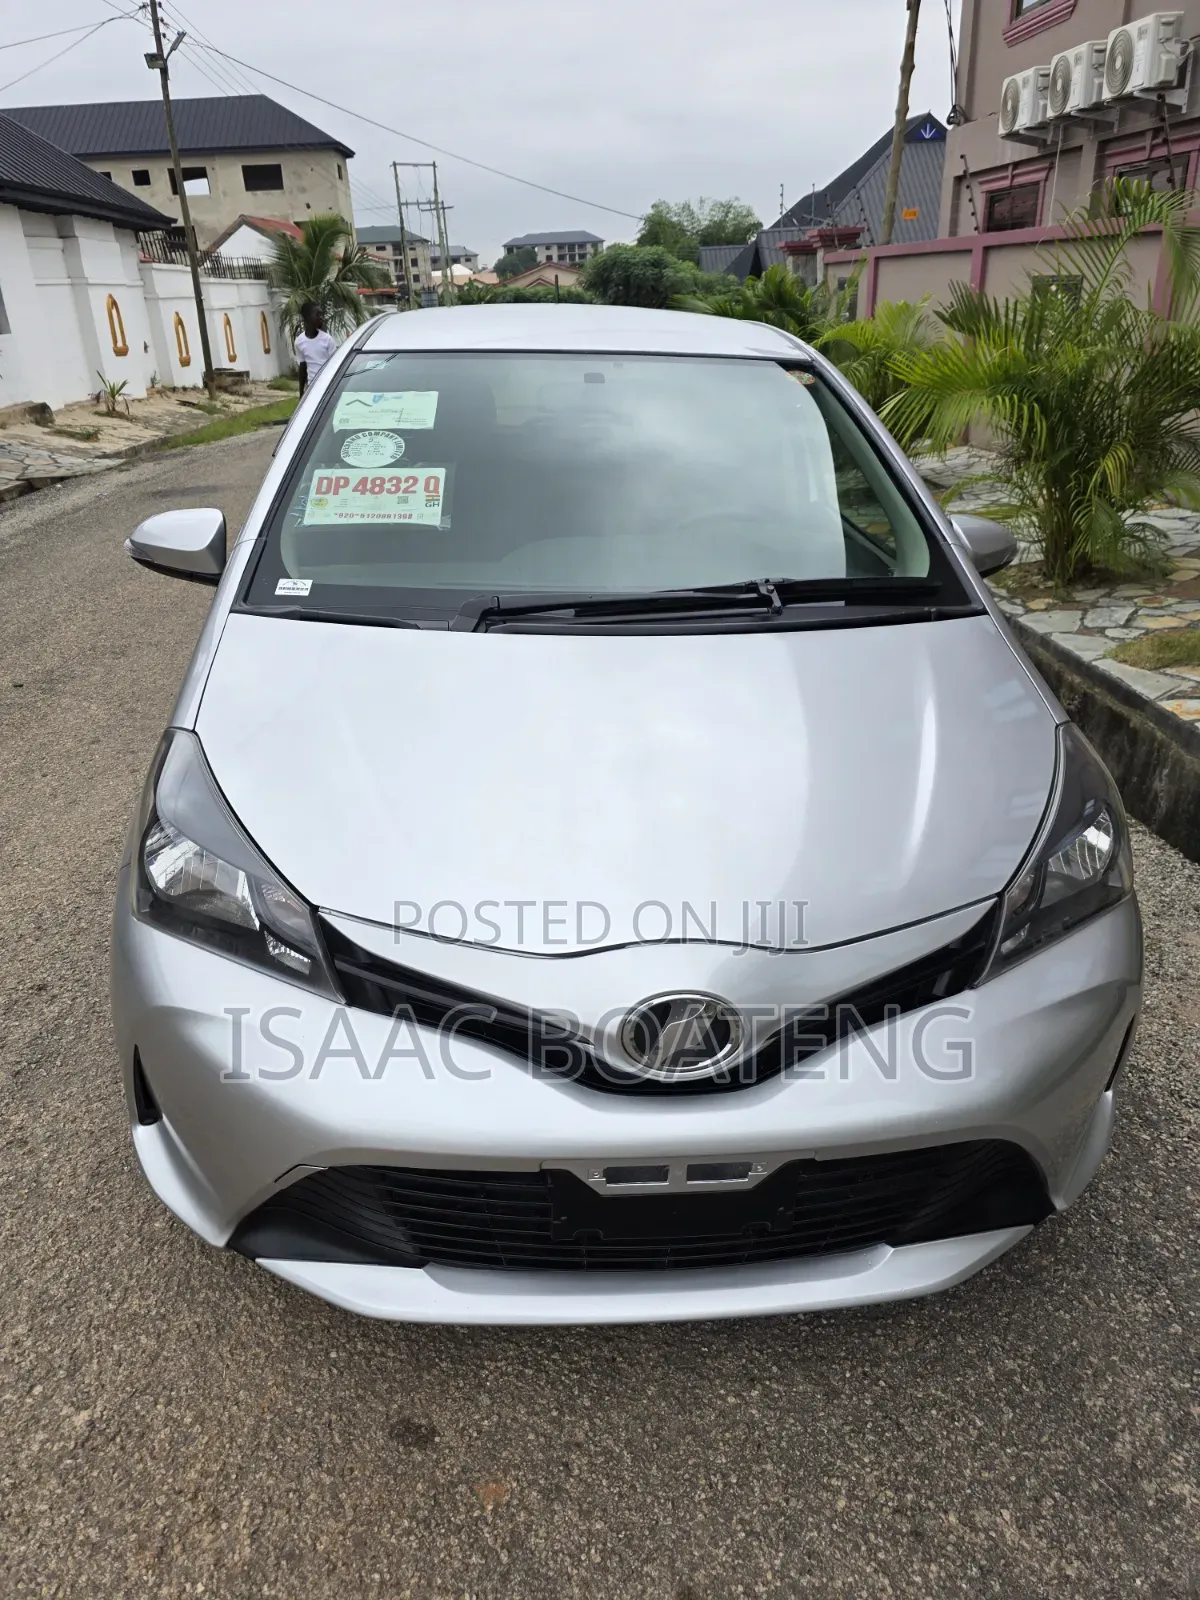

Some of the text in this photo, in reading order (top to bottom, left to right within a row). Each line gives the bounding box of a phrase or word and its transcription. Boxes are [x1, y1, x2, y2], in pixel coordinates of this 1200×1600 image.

[361, 431, 398, 442] COMPANY
[315, 475, 441, 496] DP 4832 Q
